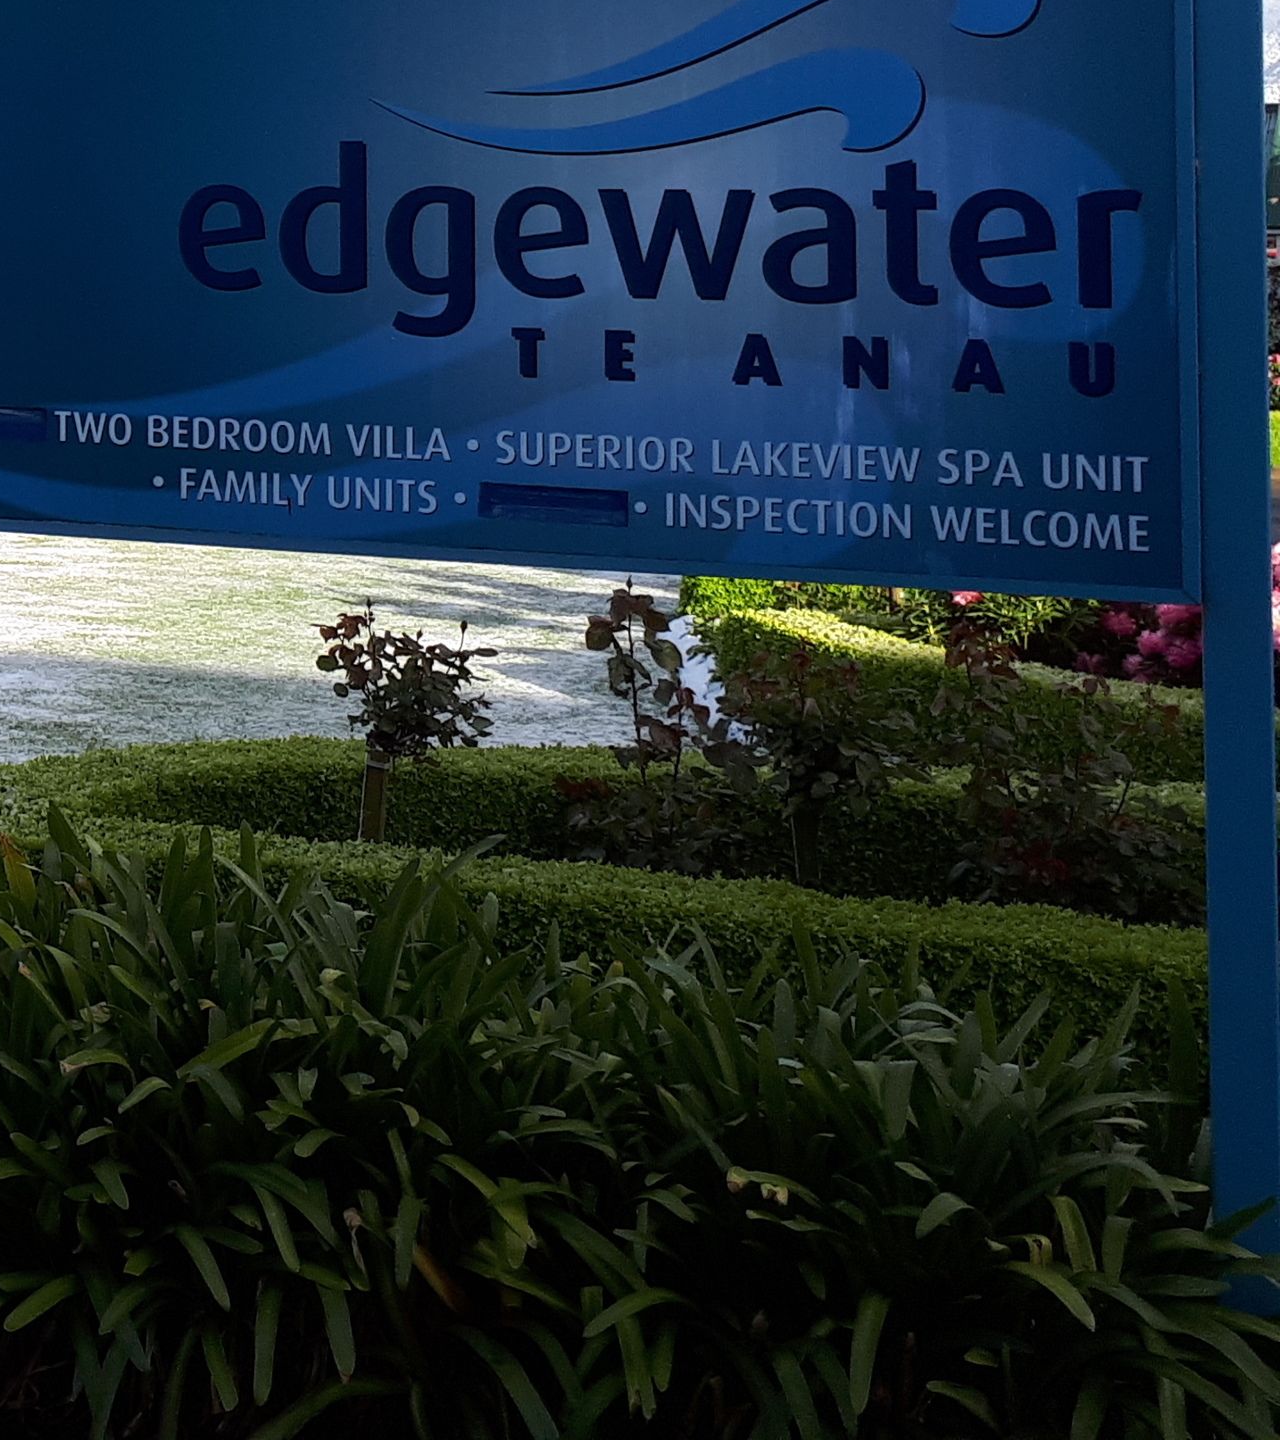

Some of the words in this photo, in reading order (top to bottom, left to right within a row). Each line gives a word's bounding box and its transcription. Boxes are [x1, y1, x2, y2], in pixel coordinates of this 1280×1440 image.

[177, 140, 1142, 337] edgewater
[511, 327, 636, 382] TE
[731, 333, 1117, 398] ANAU
[54, 411, 132, 446] TWO
[147, 415, 331, 454] BEDROOM
[346, 424, 451, 462] VILLA
[495, 430, 694, 473] SUPERIOR
[711, 440, 920, 482] LAKEVIEW
[937, 448, 1025, 488] SPA
[1042, 453, 1149, 493] UNIT
[179, 468, 313, 507] FAMILY
[327, 476, 438, 514] UNITS
[665, 492, 913, 539] INSPECTION
[929, 505, 1150, 552] WELCOME
